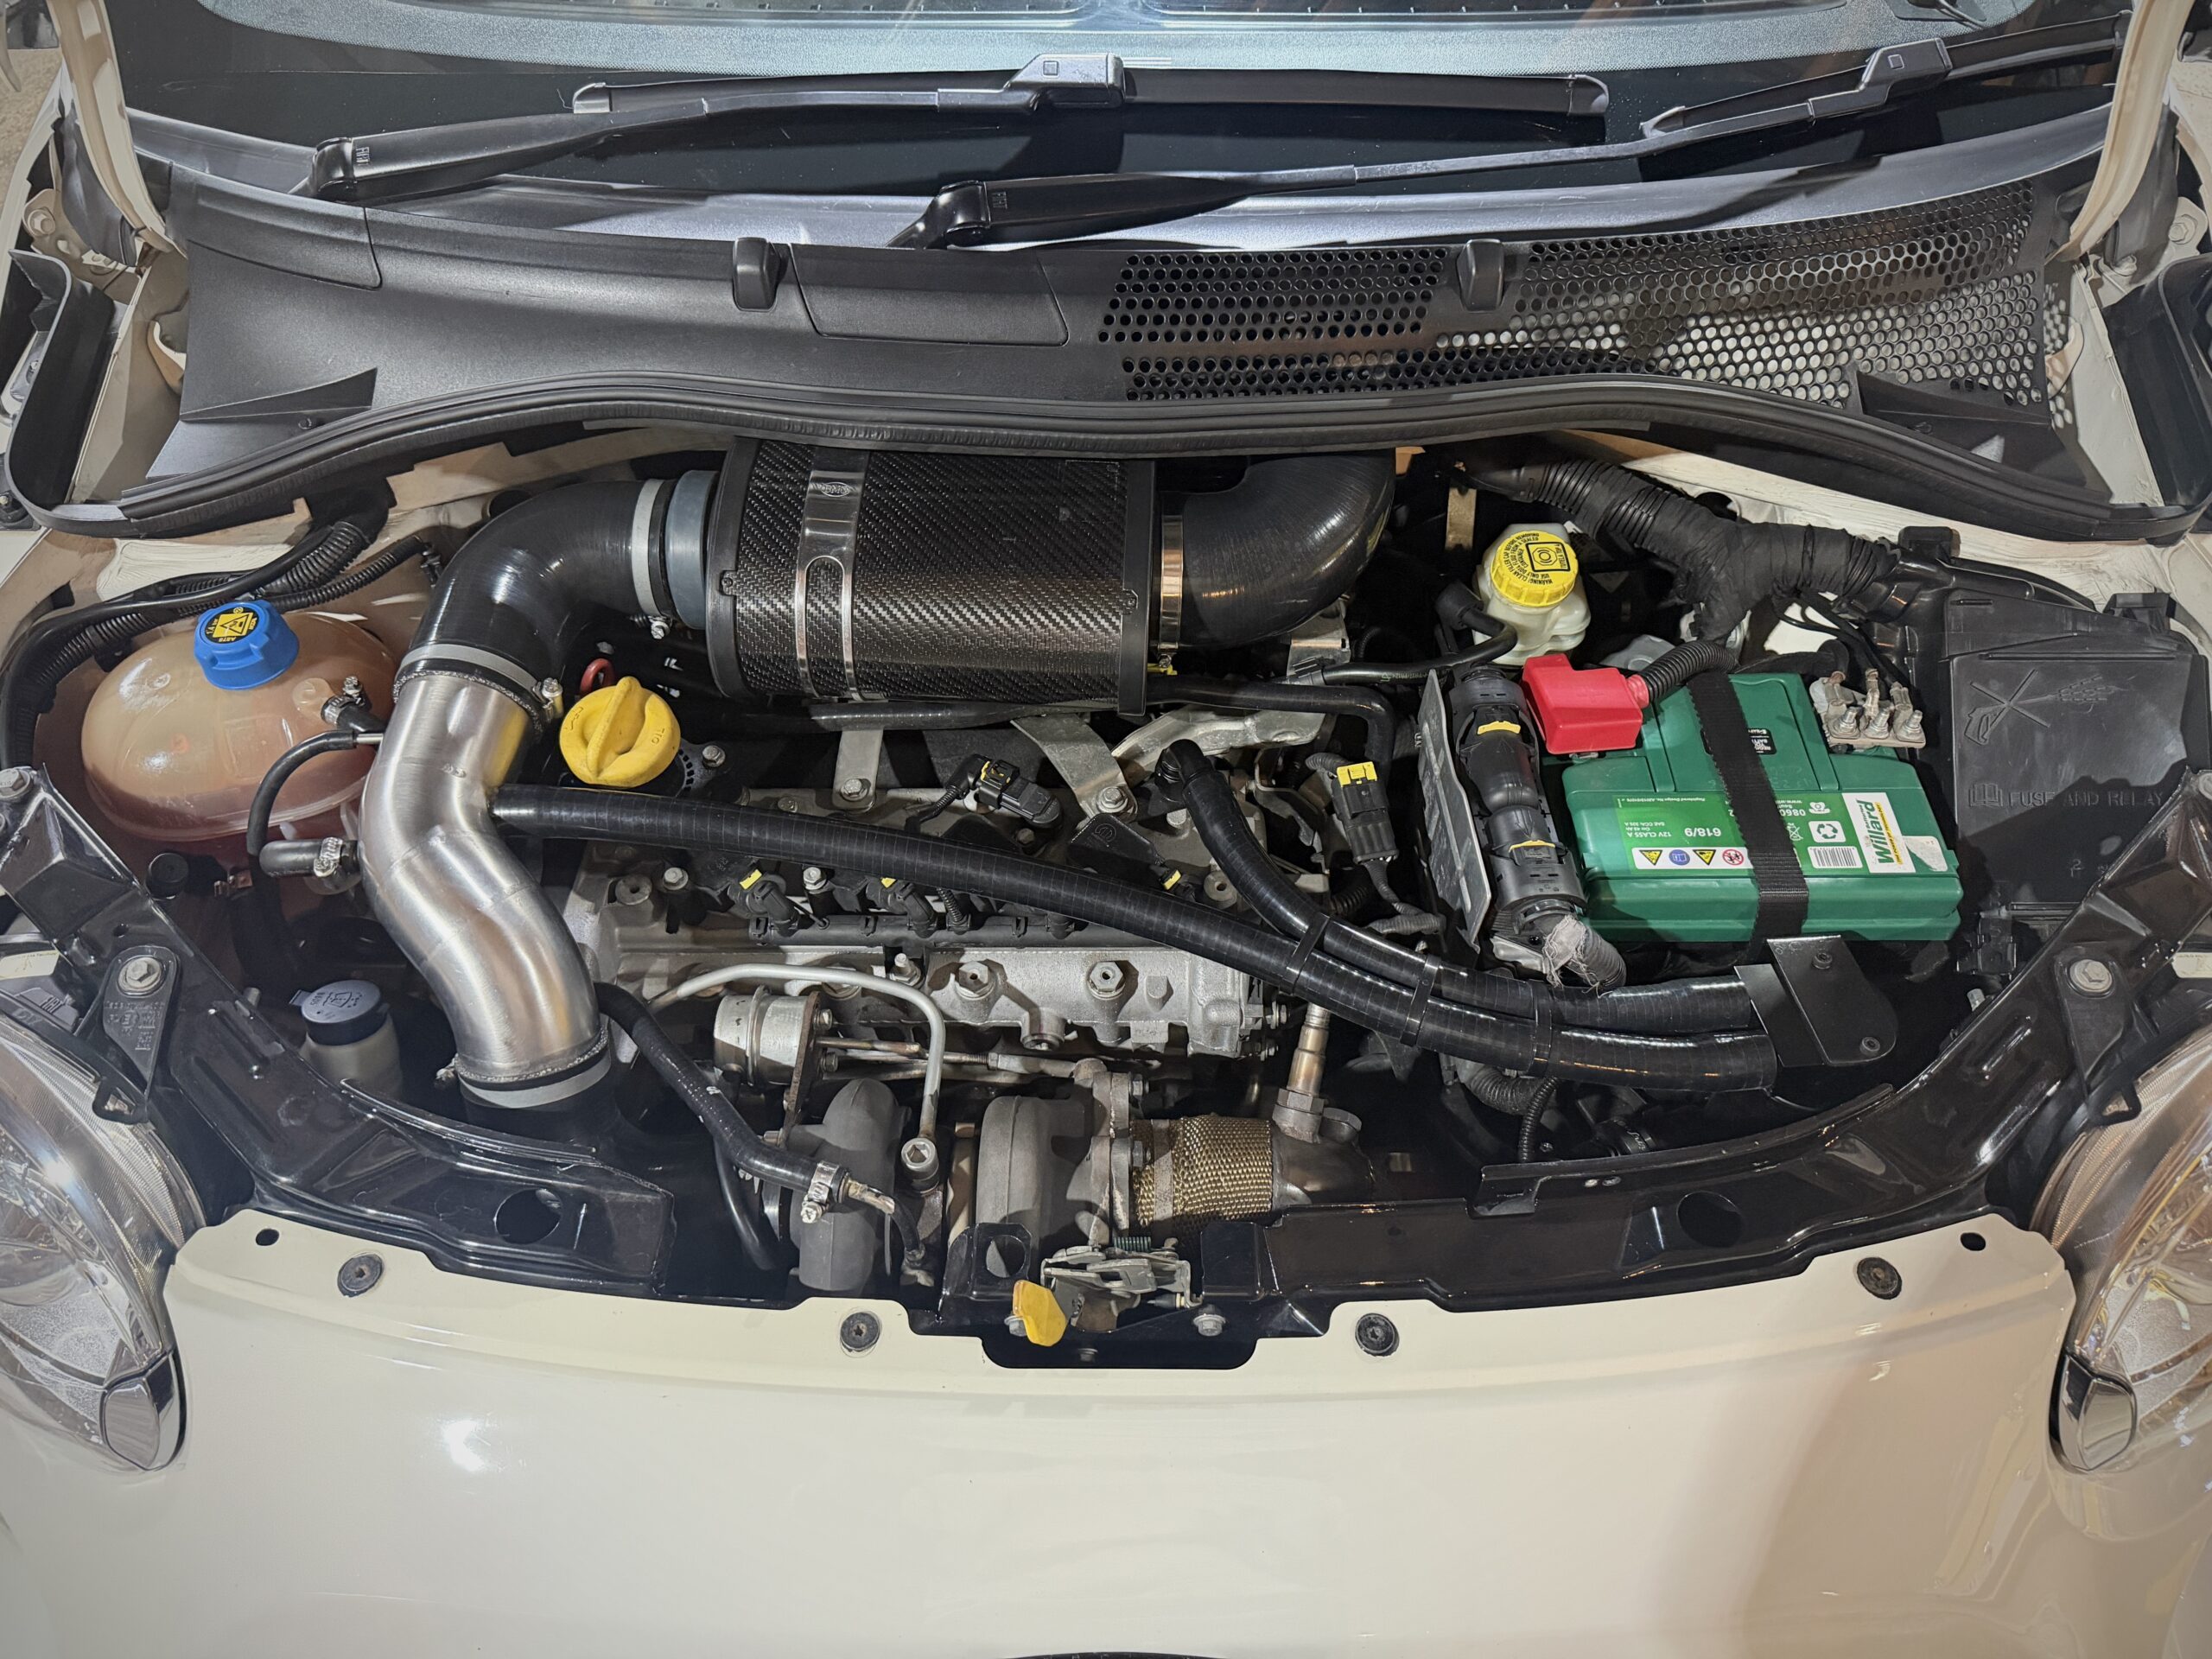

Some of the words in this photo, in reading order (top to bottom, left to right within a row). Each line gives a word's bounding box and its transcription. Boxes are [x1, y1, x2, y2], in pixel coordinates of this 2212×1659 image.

[2009, 791, 2056, 807] FUSE
[2063, 791, 2100, 806] AND
[2107, 791, 2164, 807] RELAY
[1684, 827, 1721, 837] 618/9
[1856, 799, 1894, 863] Willard
